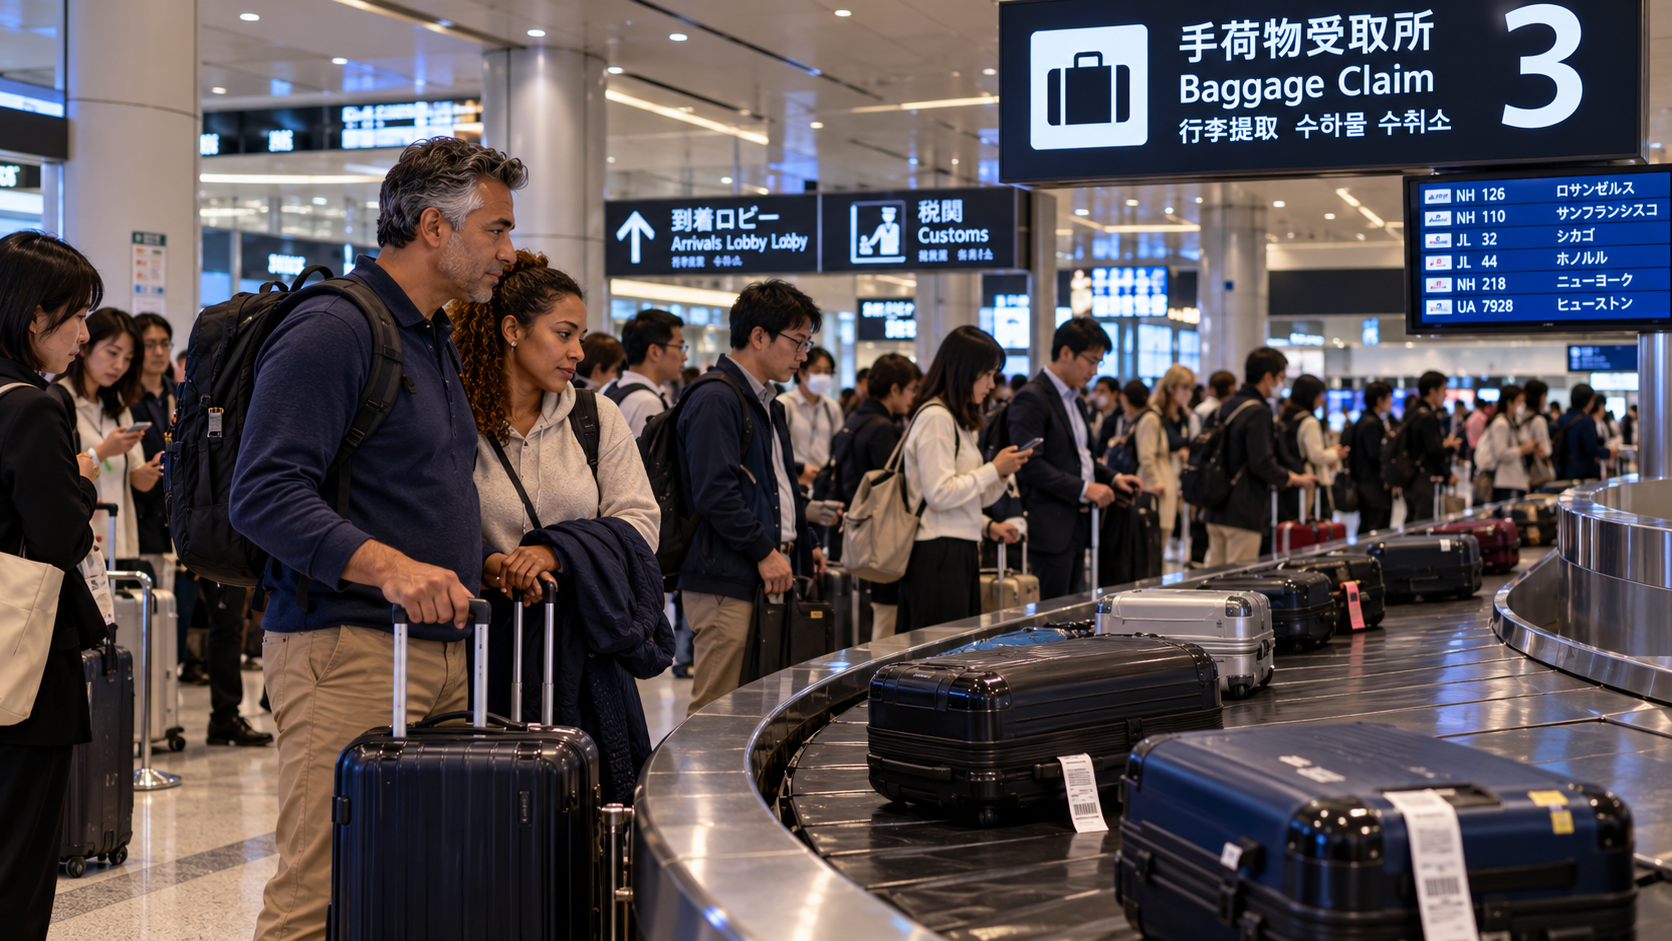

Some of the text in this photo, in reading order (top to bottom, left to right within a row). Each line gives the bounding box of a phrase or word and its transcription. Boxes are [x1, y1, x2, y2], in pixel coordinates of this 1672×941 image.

[1179, 9, 1434, 63] 手荷物受取所
[1502, 4, 1582, 128] 3
[1180, 63, 1434, 110] Baggage Claim
[1179, 116, 1279, 144] 行李提取
[1295, 109, 1452, 139] 수하물 수취소
[1457, 189, 1474, 202] NH
[1483, 188, 1505, 200] 126
[1557, 181, 1634, 197] ロサンゼルス
[671, 205, 780, 232] 到着ロビー
[918, 199, 963, 224] 税関
[1457, 211, 1475, 224] NH
[1483, 210, 1505, 223] 110
[1557, 204, 1657, 220] サンフランシスコ
[918, 226, 989, 244] Customs
[1457, 234, 1471, 246] JL
[1482, 232, 1497, 245] 32
[1557, 228, 1595, 242] シカゴ
[671, 234, 722, 251] Arrivals
[726, 234, 768, 253] Lobby
[1457, 256, 1471, 268] JL
[1482, 255, 1497, 267] 44
[1557, 251, 1607, 266] ホノルル
[1458, 278, 1475, 291] NH
[1482, 277, 1506, 290] 218
[1557, 273, 1632, 287] ニューヨーク
[1458, 300, 1476, 313] UA
[1482, 299, 1513, 312] 7928
[1558, 297, 1632, 311] ヒューストン
